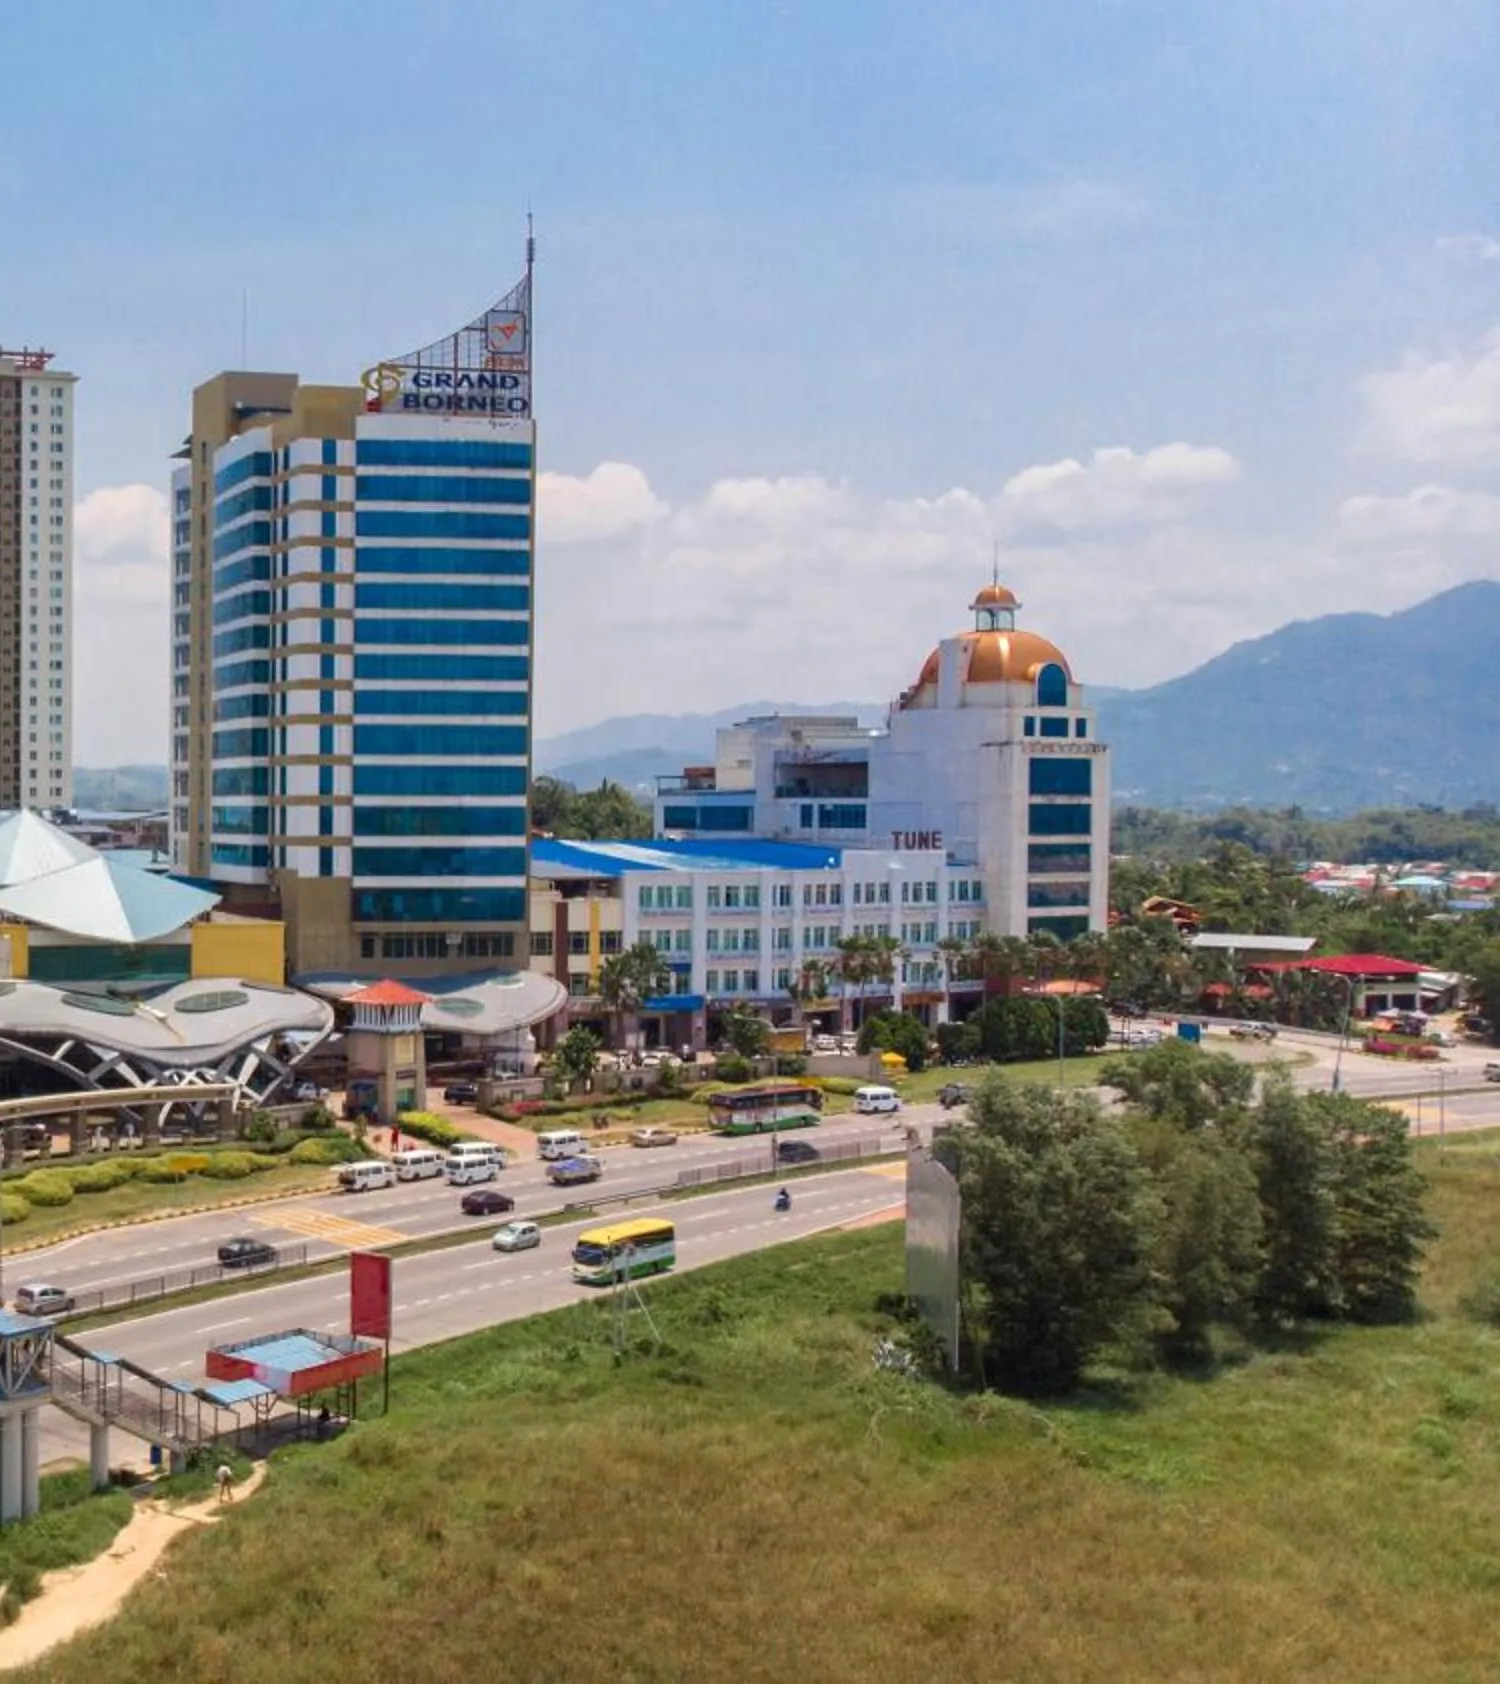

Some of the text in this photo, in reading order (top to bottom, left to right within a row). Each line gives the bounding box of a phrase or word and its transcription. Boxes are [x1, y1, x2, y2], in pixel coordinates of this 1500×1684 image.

[412, 371, 519, 390] GRAND
[403, 392, 529, 413] BORNEO
[891, 831, 943, 850] TUNE
